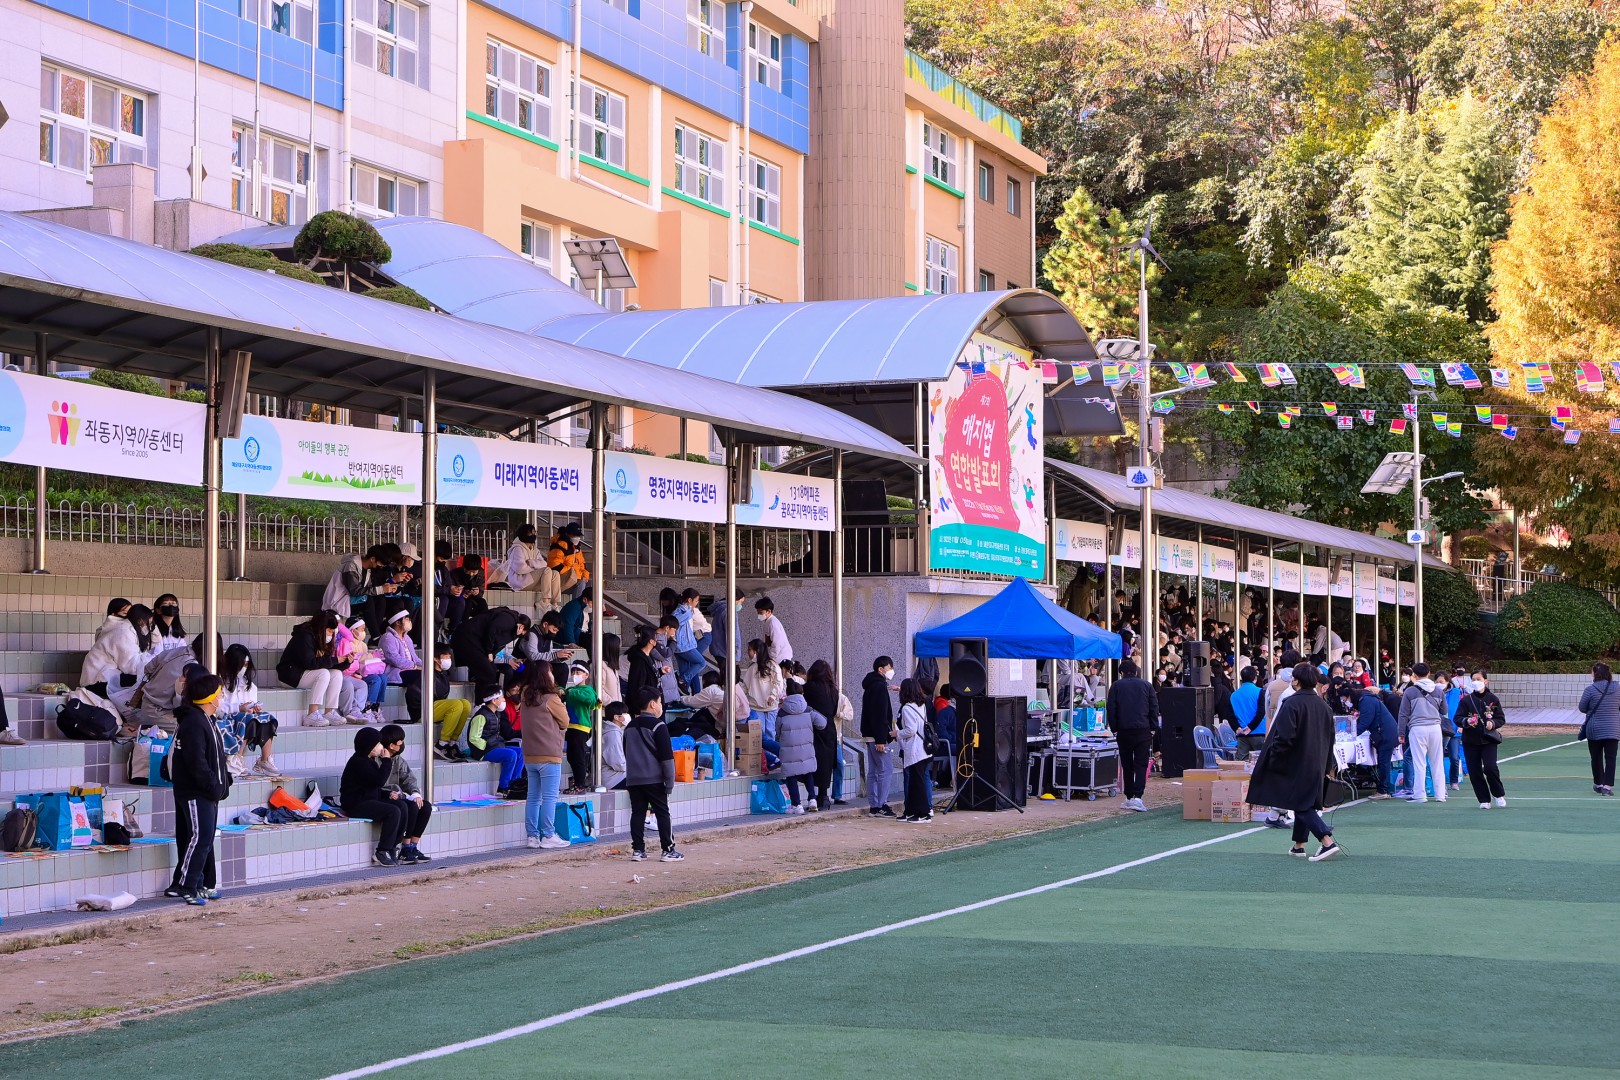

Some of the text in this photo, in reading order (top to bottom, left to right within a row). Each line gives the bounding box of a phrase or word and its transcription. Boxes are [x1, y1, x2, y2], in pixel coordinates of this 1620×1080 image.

[85, 420, 183, 454] 좌동지역아동센터
[121, 447, 149, 459] Since 2005
[298, 440, 350, 457] 아이들의 행복 공간
[348, 461, 404, 479] 반여지역아동센터
[494, 462, 579, 491] 미래지역아동센터
[950, 451, 1001, 494] 연합발표회
[648, 476, 717, 504] 명정지역아동센터
[789, 484, 820, 502] 1318해피존
[781, 502, 829, 521] 꿈&꾼지역아동센터
